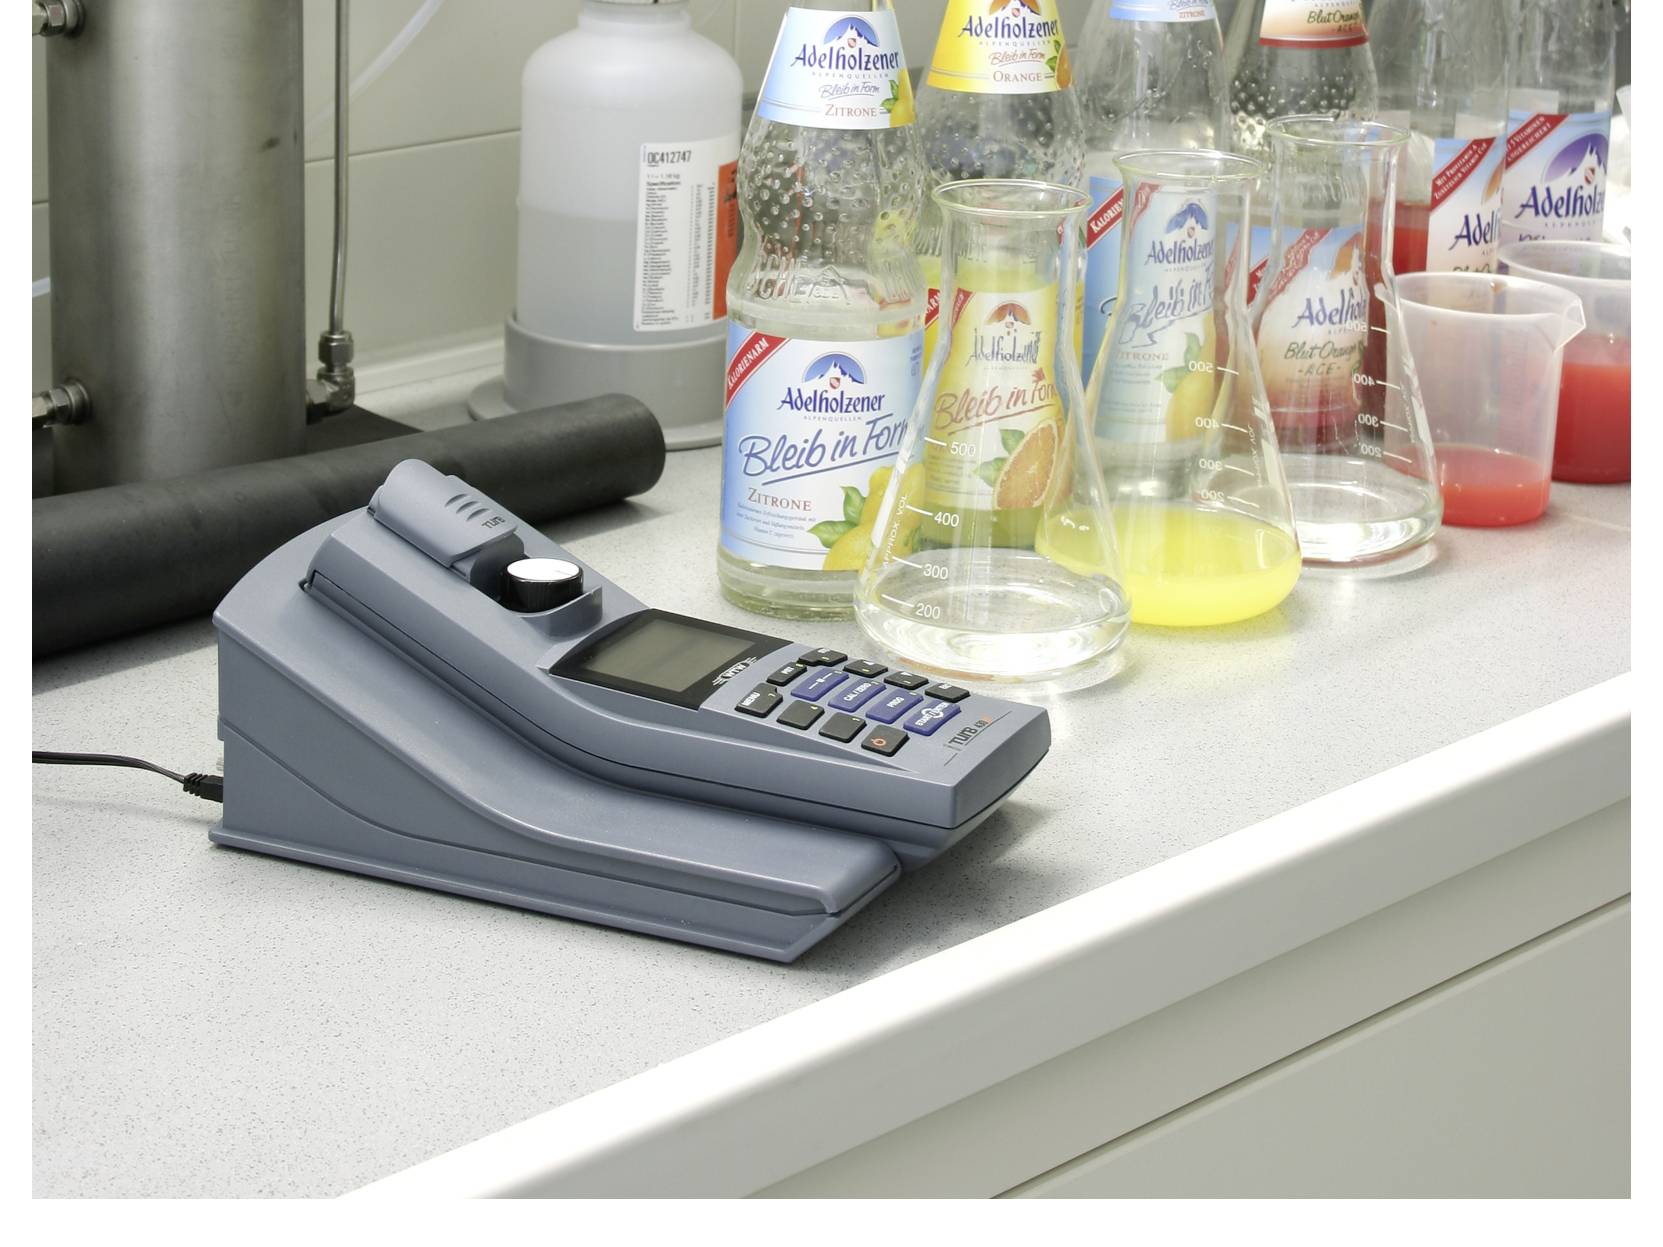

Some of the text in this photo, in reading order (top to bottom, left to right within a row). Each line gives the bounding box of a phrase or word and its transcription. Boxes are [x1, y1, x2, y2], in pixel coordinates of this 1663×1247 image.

[958, 16, 1058, 38] Adelholzener
[791, 44, 899, 71] Adelholzener
[818, 84, 850, 98] Bleib
[825, 104, 877, 117] ZITRONE
[1284, 340, 1319, 360] Blut
[777, 387, 885, 414] Adelholzener
[739, 428, 825, 477] Bleib
[831, 431, 857, 462] in
[748, 487, 812, 512] ZITRONE
[934, 512, 960, 527] 400
[923, 564, 949, 579] 300
[916, 603, 940, 619] 200
[742, 692, 760, 706] MENU
